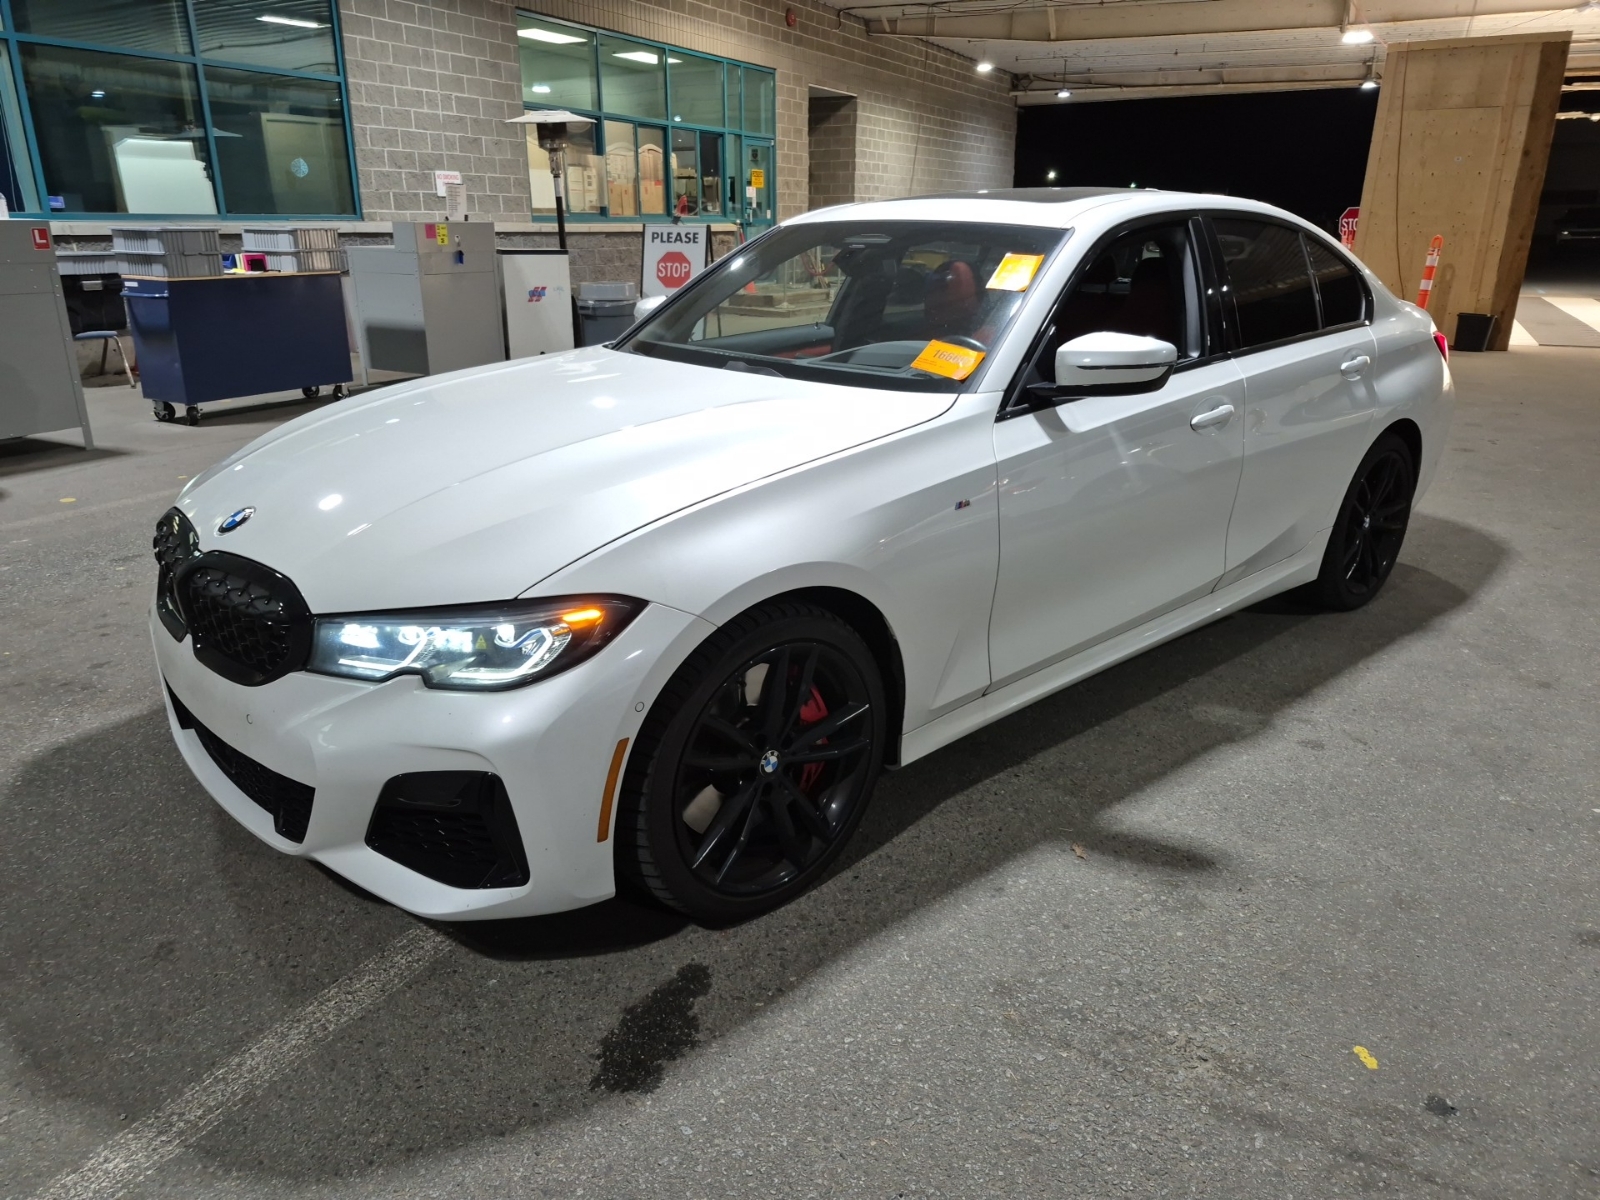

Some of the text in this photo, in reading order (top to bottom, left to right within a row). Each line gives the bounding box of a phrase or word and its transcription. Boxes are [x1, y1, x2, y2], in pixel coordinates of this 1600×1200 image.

[1342, 219, 1358, 230] STO
[34, 230, 47, 243] L
[651, 231, 699, 244] PLEASE
[658, 262, 690, 278] STOP
